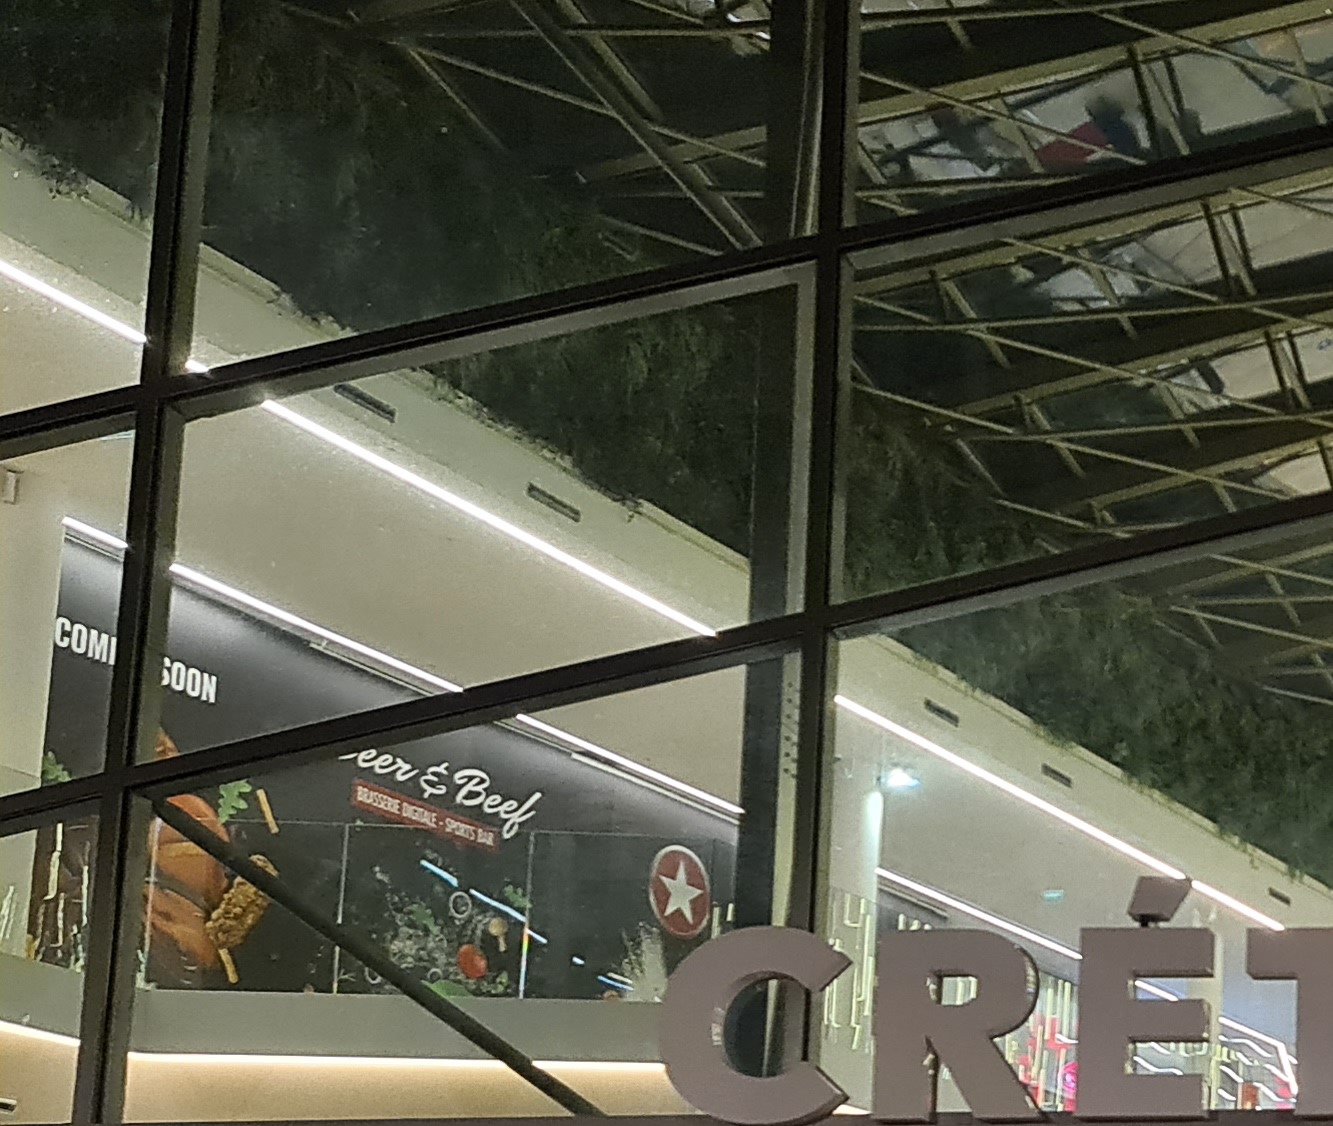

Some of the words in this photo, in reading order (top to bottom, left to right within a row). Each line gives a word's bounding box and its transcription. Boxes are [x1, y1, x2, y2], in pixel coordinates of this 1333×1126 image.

[55, 615, 118, 666] COMI
[161, 656, 218, 703] SOON
[338, 748, 419, 782] eer
[420, 761, 450, 799] &
[454, 768, 543, 840] Beef
[356, 785, 401, 814] BRASSERIE
[445, 817, 476, 841] SPORTS
[477, 828, 494, 847] BAR
